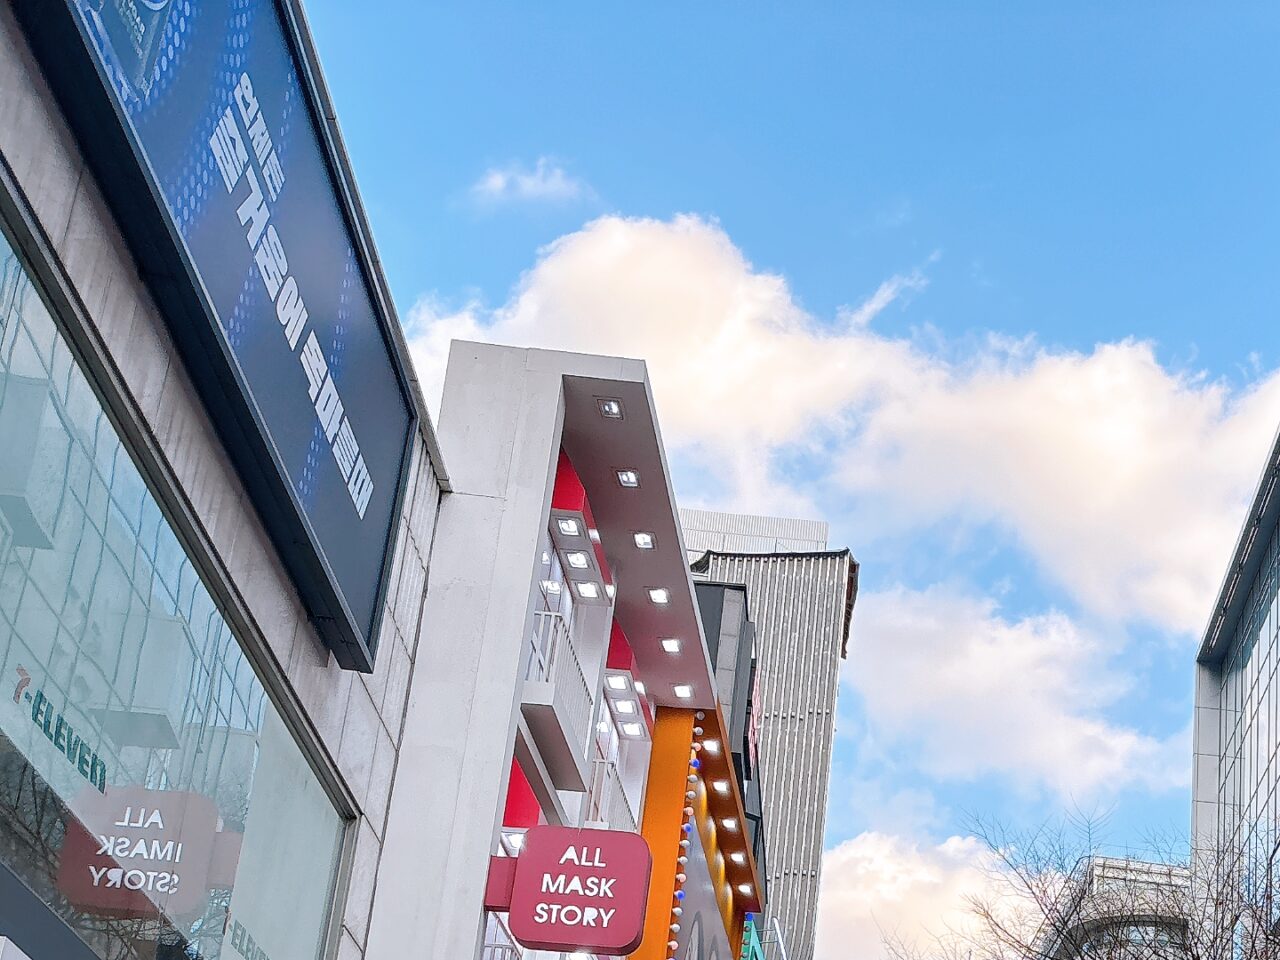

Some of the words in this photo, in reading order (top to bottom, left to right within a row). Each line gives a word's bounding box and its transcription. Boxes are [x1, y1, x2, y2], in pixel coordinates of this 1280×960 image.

[559, 845, 606, 868] ALL
[541, 873, 616, 898] MASK
[533, 902, 615, 928] STORY
